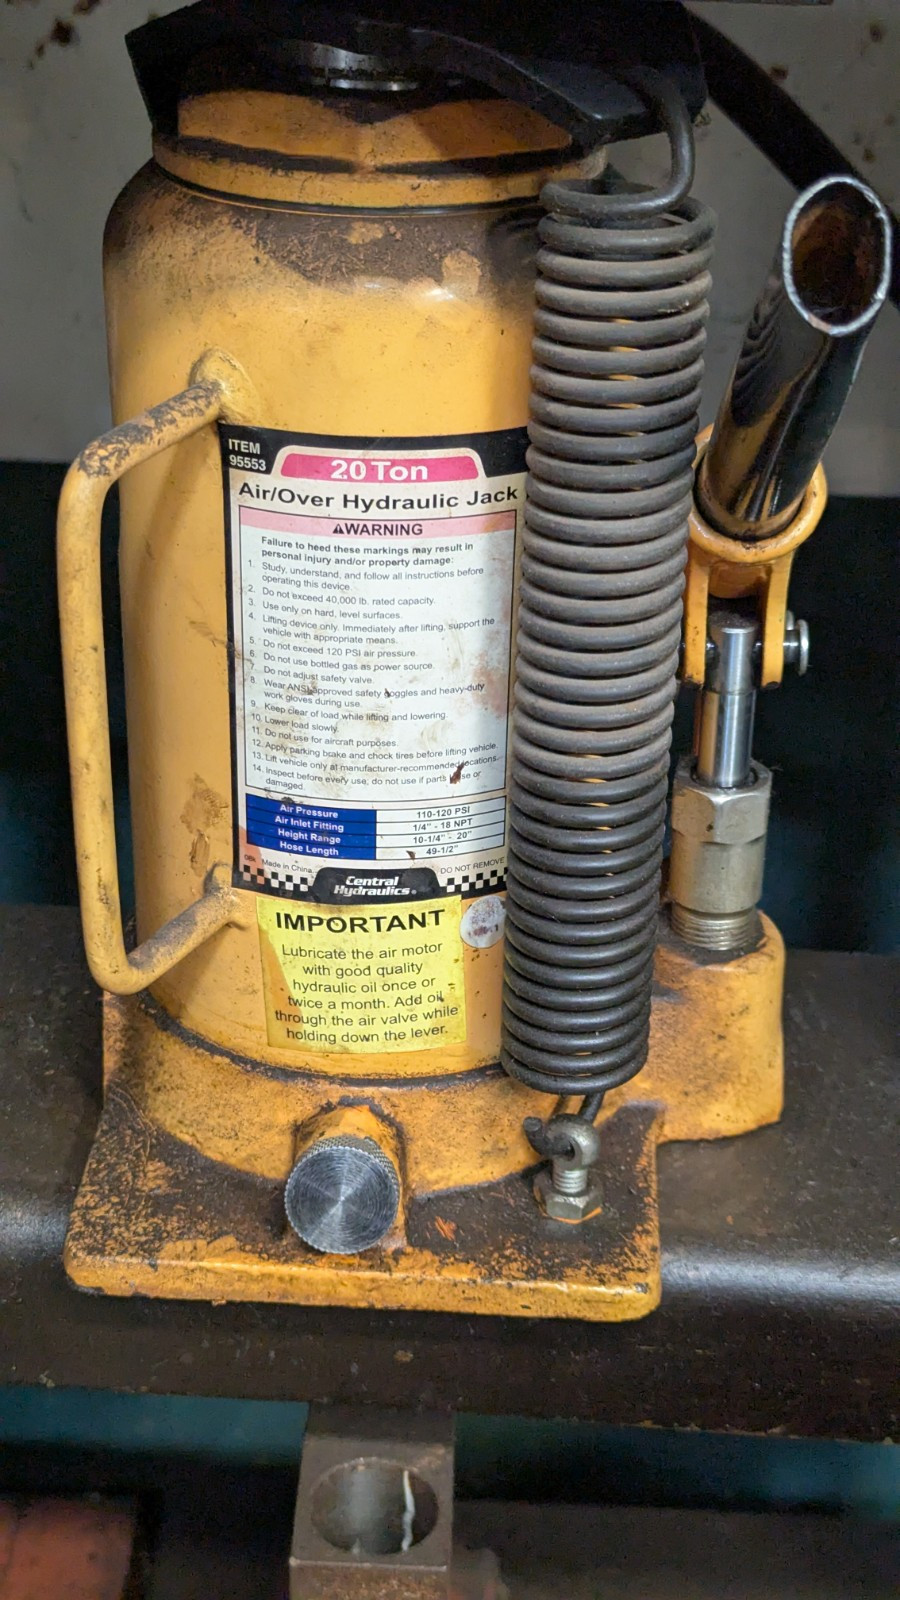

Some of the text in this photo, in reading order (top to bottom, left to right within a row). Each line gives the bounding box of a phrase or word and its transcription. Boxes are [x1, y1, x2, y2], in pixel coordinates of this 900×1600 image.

[229, 439, 260, 454] ITEM
[229, 455, 266, 471] 95553
[331, 460, 428, 480] 20 Ton
[239, 482, 518, 512] Air/Over Hydraulic Jack
[345, 523, 423, 535] WARNING
[262, 536, 462, 556] Failure heed these markings may result
[262, 550, 301, 560] personal
[305, 554, 331, 565] injury
[369, 559, 409, 567] property
[413, 557, 453, 565] damage:
[262, 562, 287, 574] Study,
[290, 568, 341, 579] understand,
[405, 570, 454, 579] instructions
[457, 568, 484, 577] before
[262, 575, 301, 587] operating
[304, 579, 318, 588] this
[292, 592, 323, 602] exceed
[326, 596, 356, 605] 40,000
[398, 598, 435, 606] capacity.
[263, 601, 279, 610] Use
[282, 605, 298, 614] only
[315, 609, 336, 618] hard,
[263, 615, 287, 627] Lifting
[290, 620, 317, 629] device
[320, 623, 339, 632] only.
[343, 624, 396, 633] Immediately
[399, 624, 418, 632] after
[421, 624, 445, 632] lifting,
[448, 620, 480, 630] support
[263, 627, 291, 637] vehicle
[294, 631, 311, 639] with
[313, 634, 363, 644] appropriate
[293, 645, 323, 654] exceed
[327, 648, 342, 656] 120
[364, 649, 374, 657] air
[293, 658, 308, 666] use
[311, 658, 339, 669] bottled
[342, 663, 358, 672] gas
[293, 671, 318, 681] adjust
[321, 673, 346, 683] safety
[264, 679, 285, 689] Wear
[355, 690, 381, 698] safety
[440, 683, 485, 695] heavy-duty
[264, 691, 283, 700] work
[286, 694, 312, 704] gloves
[315, 698, 342, 707] during
[265, 703, 285, 714] Keep
[288, 707, 307, 716] clear
[321, 710, 338, 719] load
[367, 713, 389, 722] lifting
[411, 712, 448, 720] lowering.
[265, 716, 339, 733] Lower load slowly.
[294, 734, 398, 747] use aircraft purposes.
[265, 741, 287, 753] Apply
[290, 747, 320, 758] parking
[323, 750, 346, 758] brake
[396, 751, 413, 759] tires
[417, 750, 443, 758] before
[446, 747, 466, 756] lifting
[469, 743, 498, 752] vehicle.
[266, 754, 327, 771] Lift vehicle only
[266, 767, 294, 778] Inspect
[297, 773, 323, 781] before
[325, 776, 348, 785] every
[426, 776, 446, 784] parts
[280, 804, 338, 818] Air Pressure
[417, 806, 470, 818] 110-120 PSI
[291, 819, 311, 828] Inlet
[314, 822, 344, 832] Fitting
[454, 818, 473, 827] NPT
[278, 829, 341, 844] Height Range
[280, 841, 338, 856] Hose Length
[473, 857, 504, 869] REMOVE
[346, 876, 399, 886] Central
[334, 885, 410, 896] Hydraulics
[276, 909, 445, 933] IMPORTANT
[282, 942, 442, 960] Lubricate the air motor
[303, 962, 423, 979] with good quality
[293, 978, 436, 993] hydraulic oil once or
[288, 991, 444, 1010] twice a month. Add oil
[275, 1004, 458, 1028] through the air valve while
[286, 1024, 448, 1044] holding down the lever.
